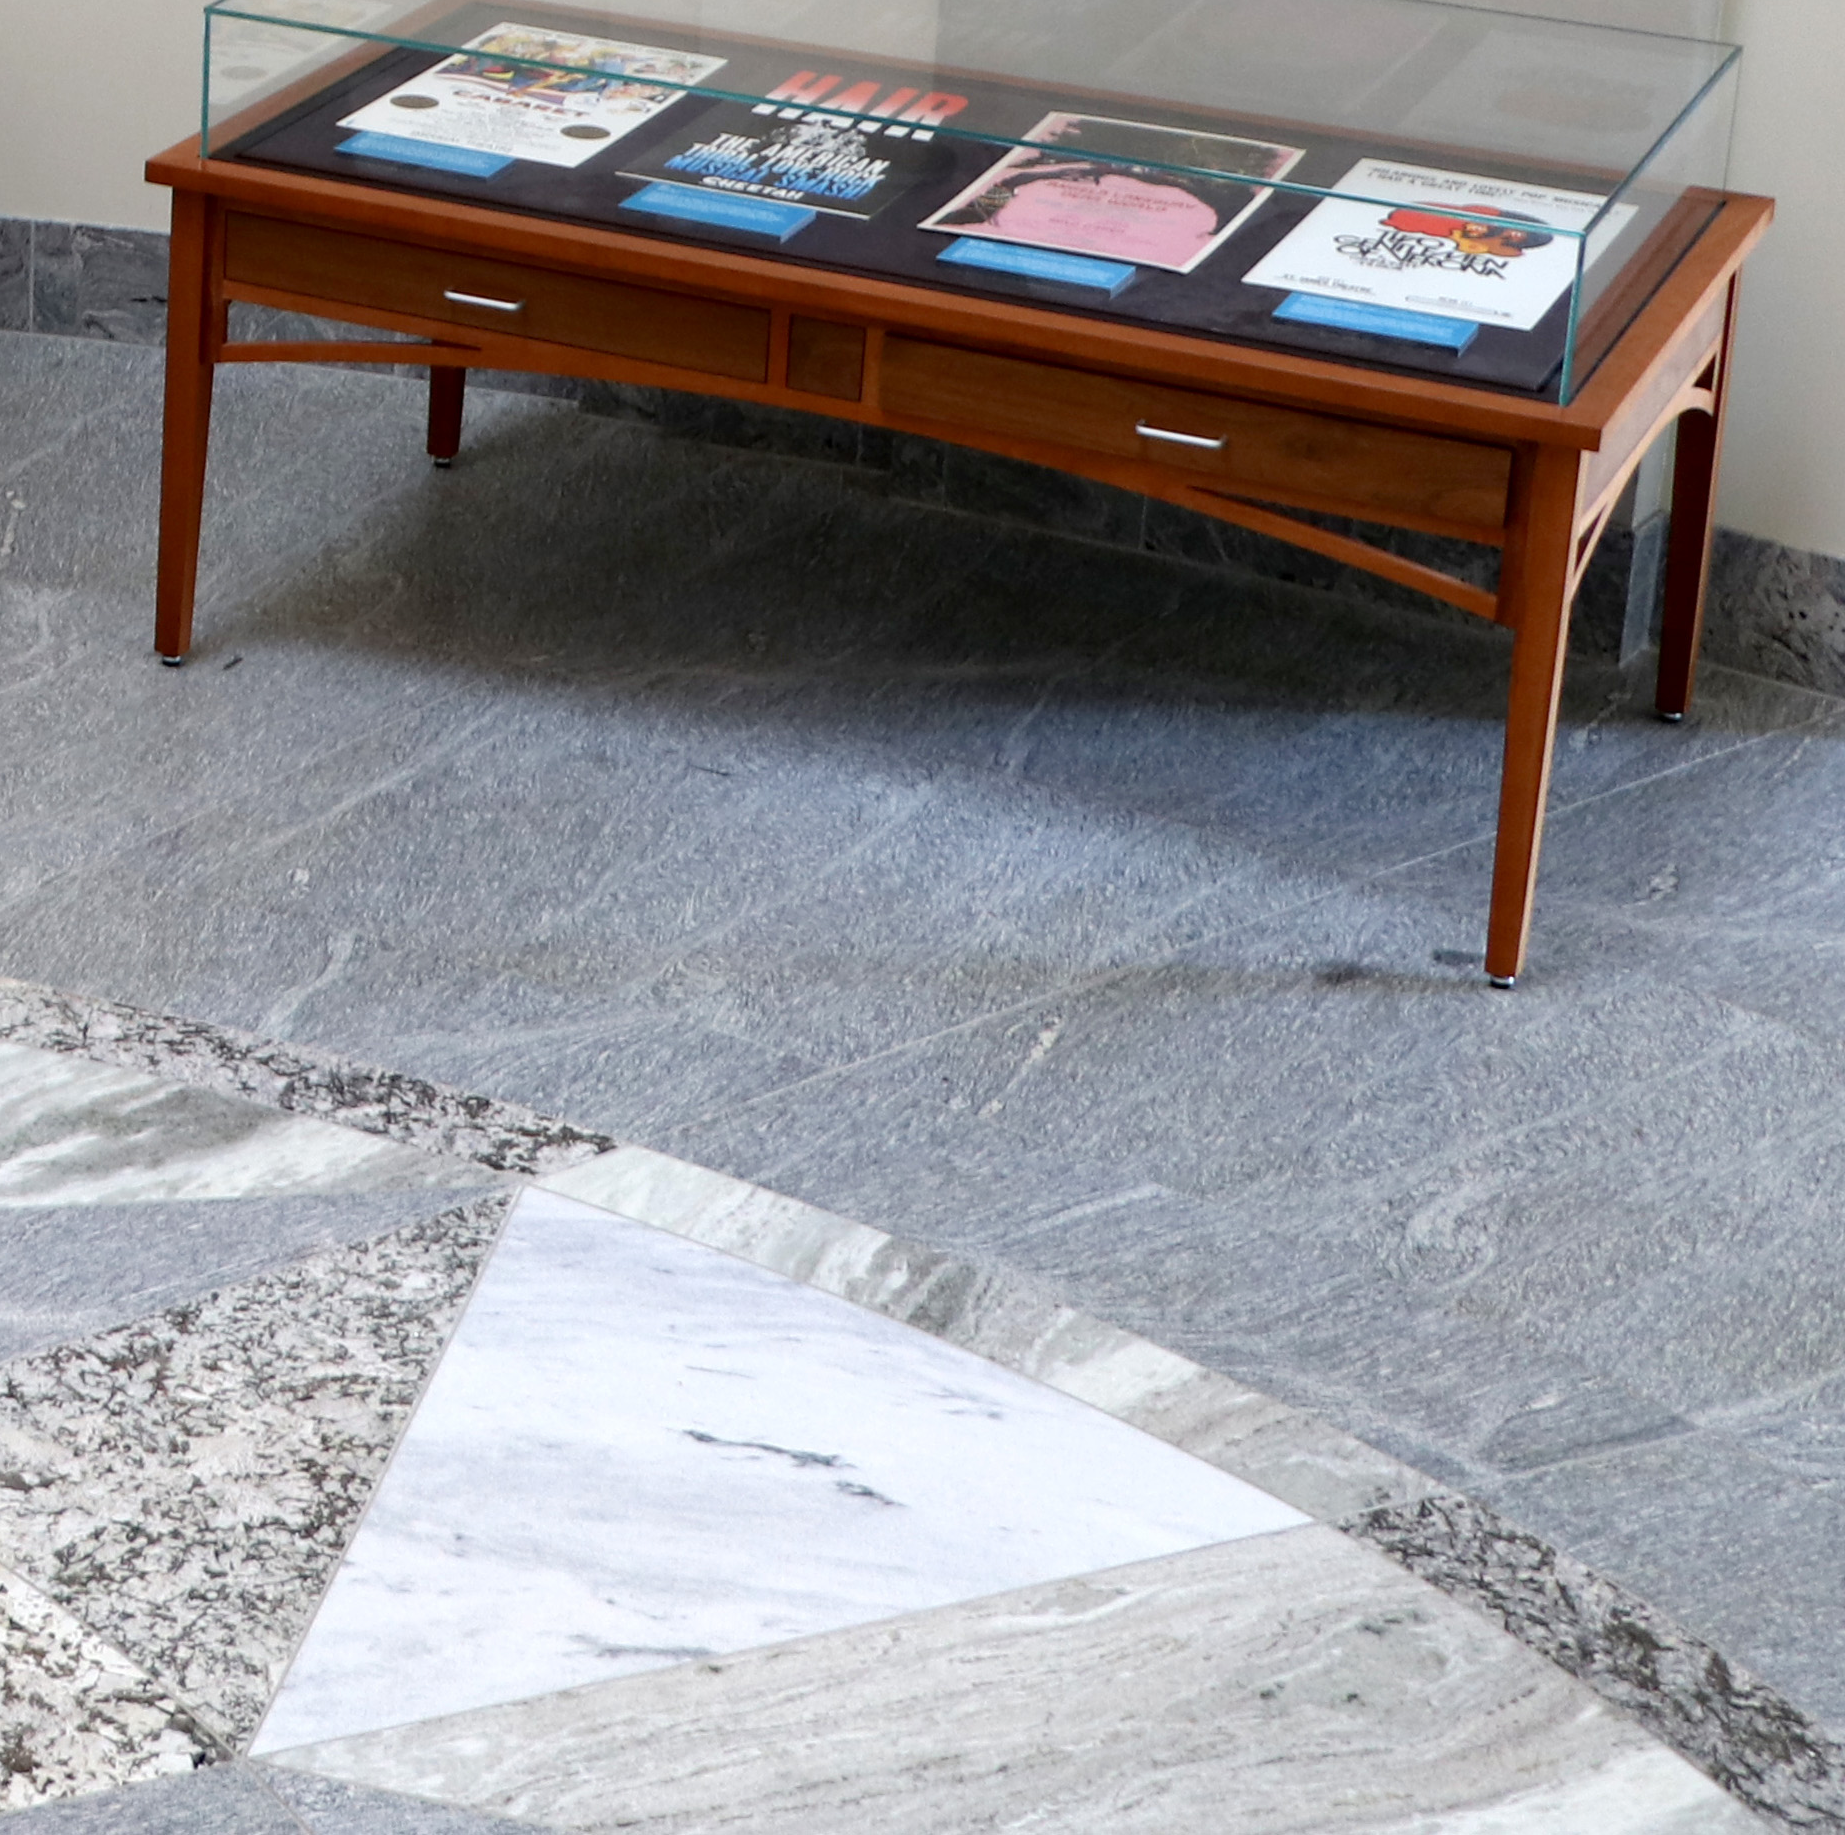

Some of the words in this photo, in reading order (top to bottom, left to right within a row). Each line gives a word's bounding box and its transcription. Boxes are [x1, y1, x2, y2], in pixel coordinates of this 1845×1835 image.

[750, 69, 970, 143] HAIR
[684, 142, 759, 167] TRIBAL
[708, 133, 760, 153] THE
[760, 143, 891, 174] AMERICAN
[663, 154, 769, 184] MUSICAL
[773, 175, 875, 201] SMASH!
[698, 176, 805, 200] CHEETAH
